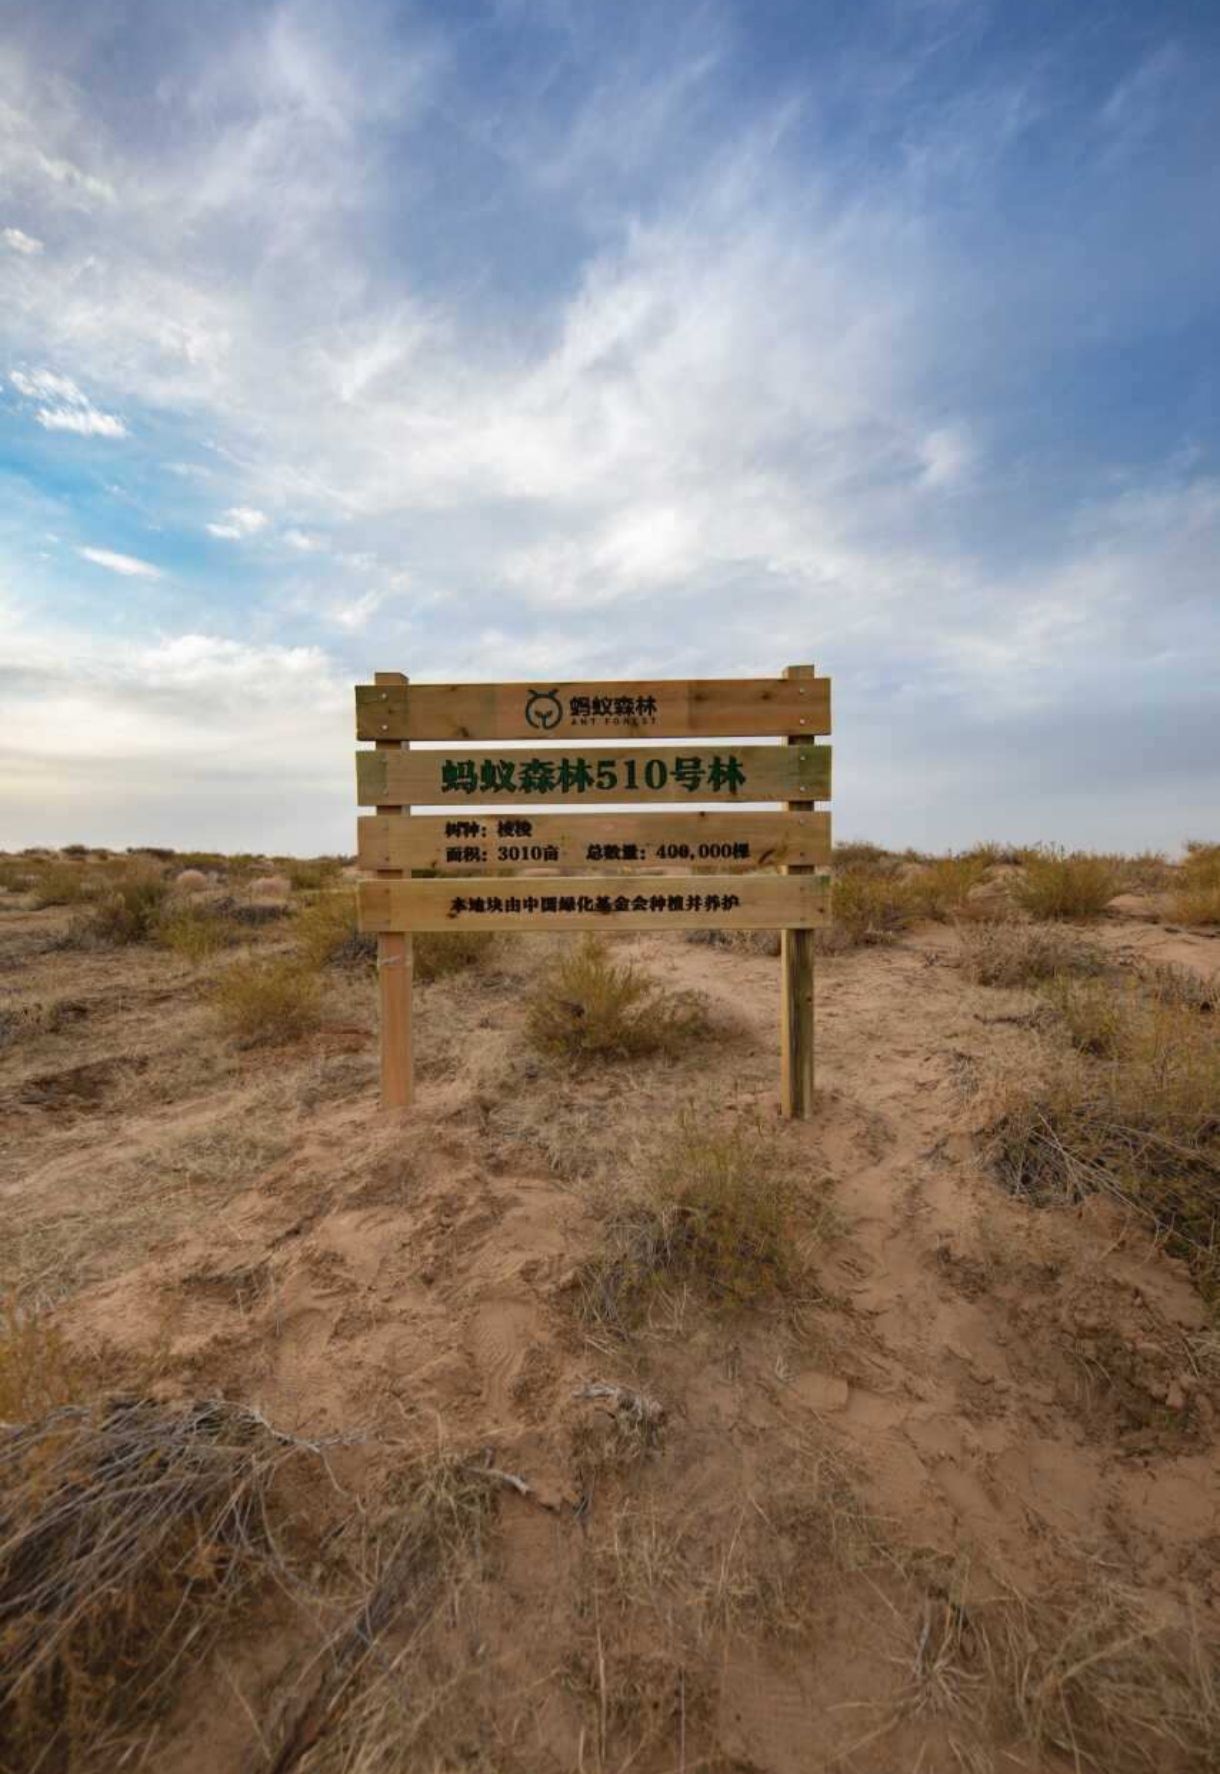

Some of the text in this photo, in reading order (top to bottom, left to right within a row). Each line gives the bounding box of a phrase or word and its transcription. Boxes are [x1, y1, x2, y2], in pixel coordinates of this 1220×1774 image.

[569, 695, 657, 716] 蚂蚁森林
[441, 756, 746, 795] 蚂蚁森林510号林
